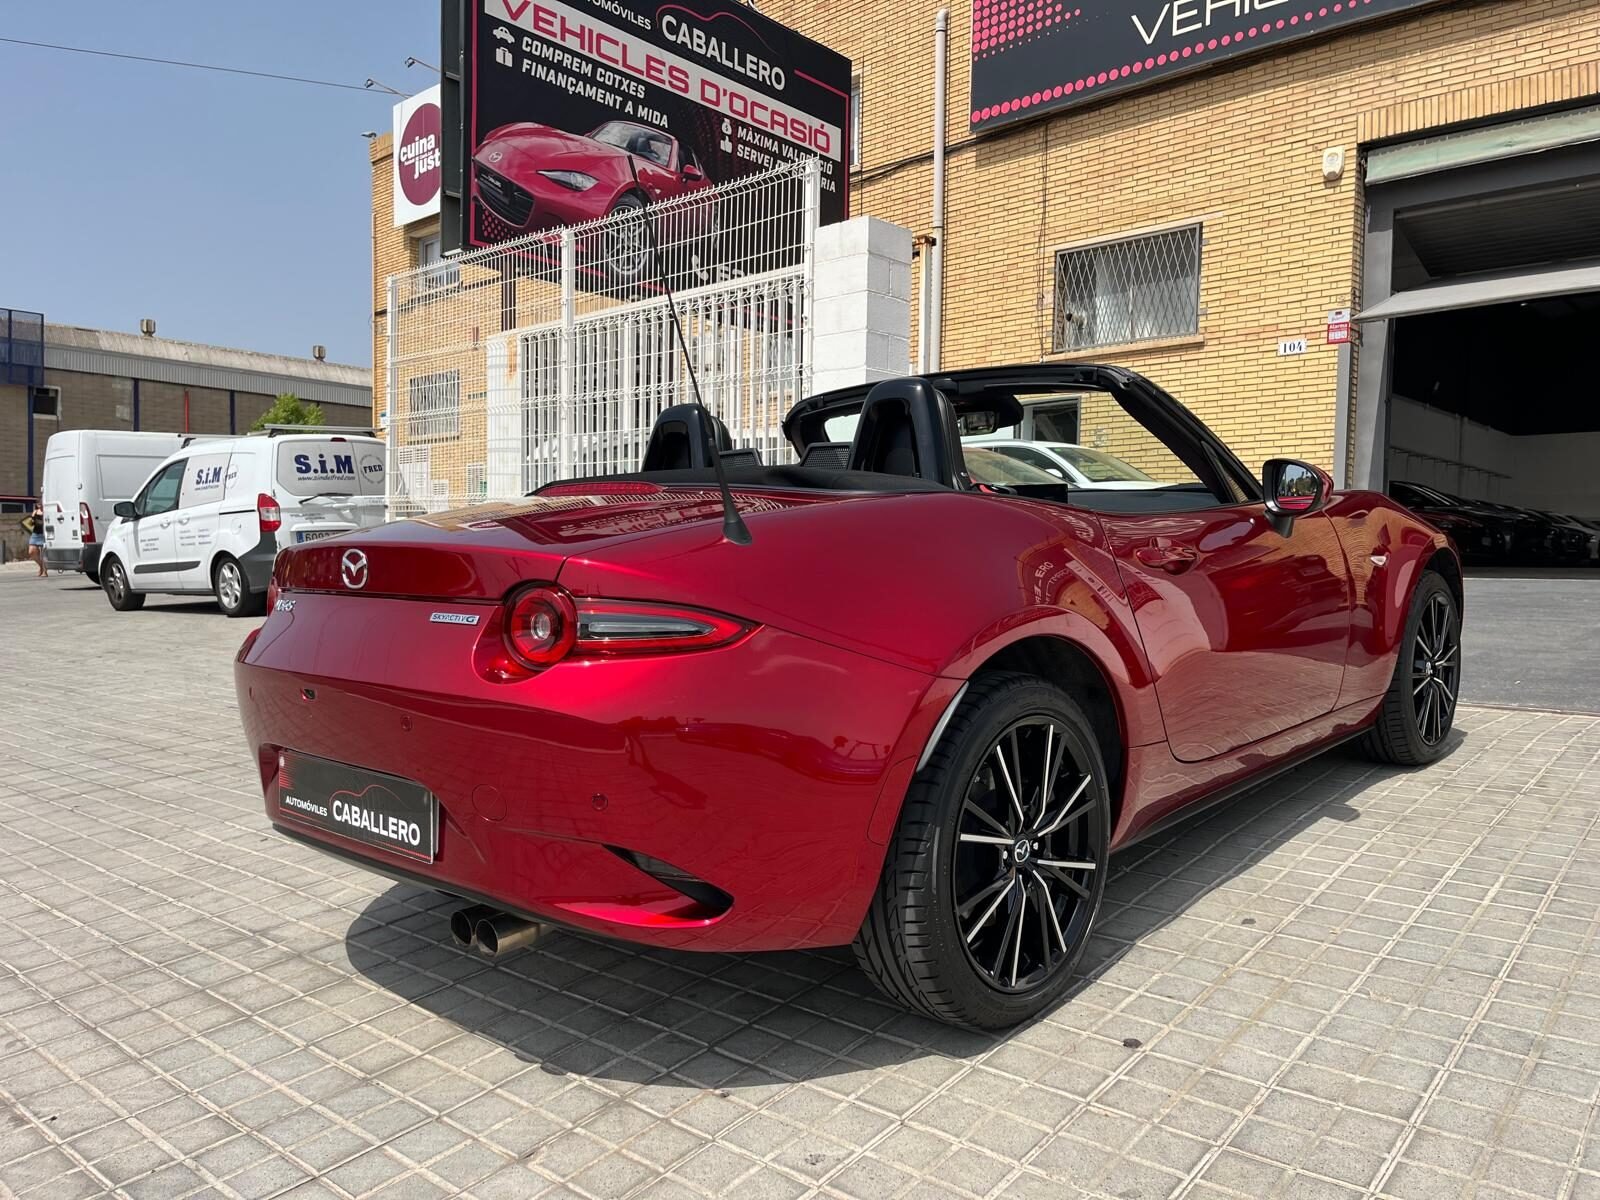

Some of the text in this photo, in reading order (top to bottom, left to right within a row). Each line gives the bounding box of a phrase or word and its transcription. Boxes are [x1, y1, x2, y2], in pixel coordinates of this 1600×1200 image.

[521, 36, 646, 99] COMPREM COTXES
[662, 14, 786, 91] CABALLERO
[502, 0, 831, 154] VEHICLES D'OCASIÓ
[521, 58, 669, 129] FINANÇAMENT A MIDA
[400, 134, 435, 162] cuina
[737, 126, 779, 154] MÀXIMA
[414, 148, 441, 180] just
[737, 144, 773, 171] SERVEI
[1284, 341, 1303, 354] 104
[363, 464, 384, 474] FRED
[285, 795, 421, 846] AUTOMÓVILES CABALLERO
